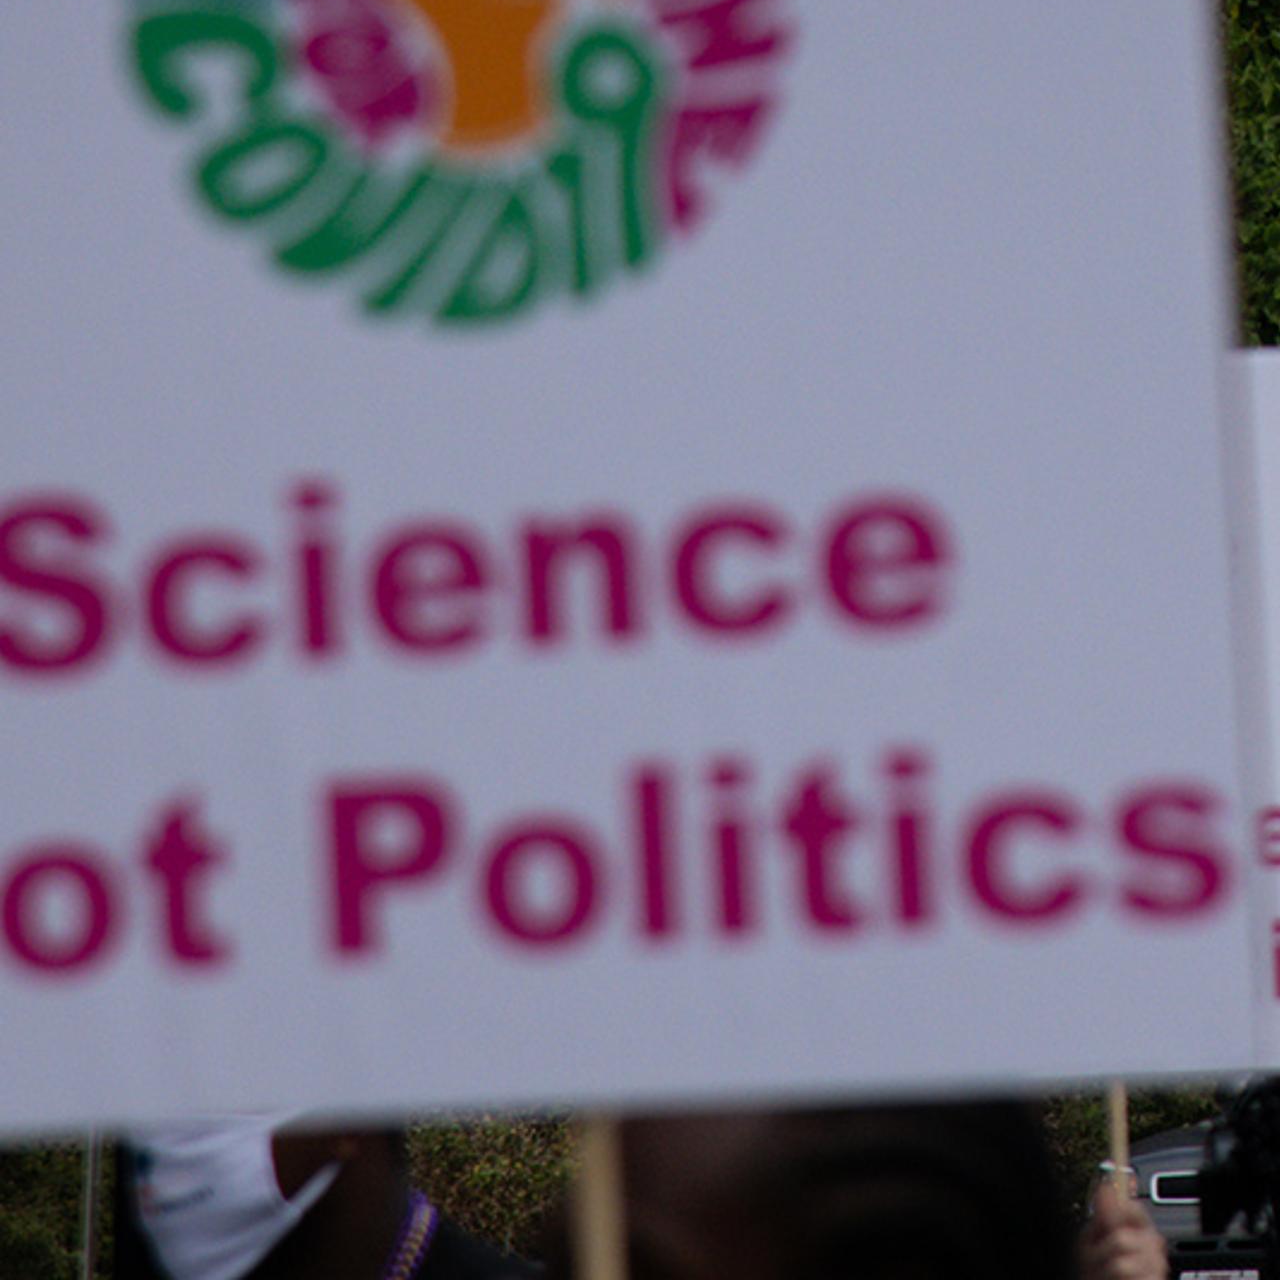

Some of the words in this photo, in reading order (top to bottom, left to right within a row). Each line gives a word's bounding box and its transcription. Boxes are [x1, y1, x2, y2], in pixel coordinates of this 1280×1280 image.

[0, 482, 952, 680] Science
[0, 800, 226, 982] ot
[320, 748, 1234, 962] Politics
